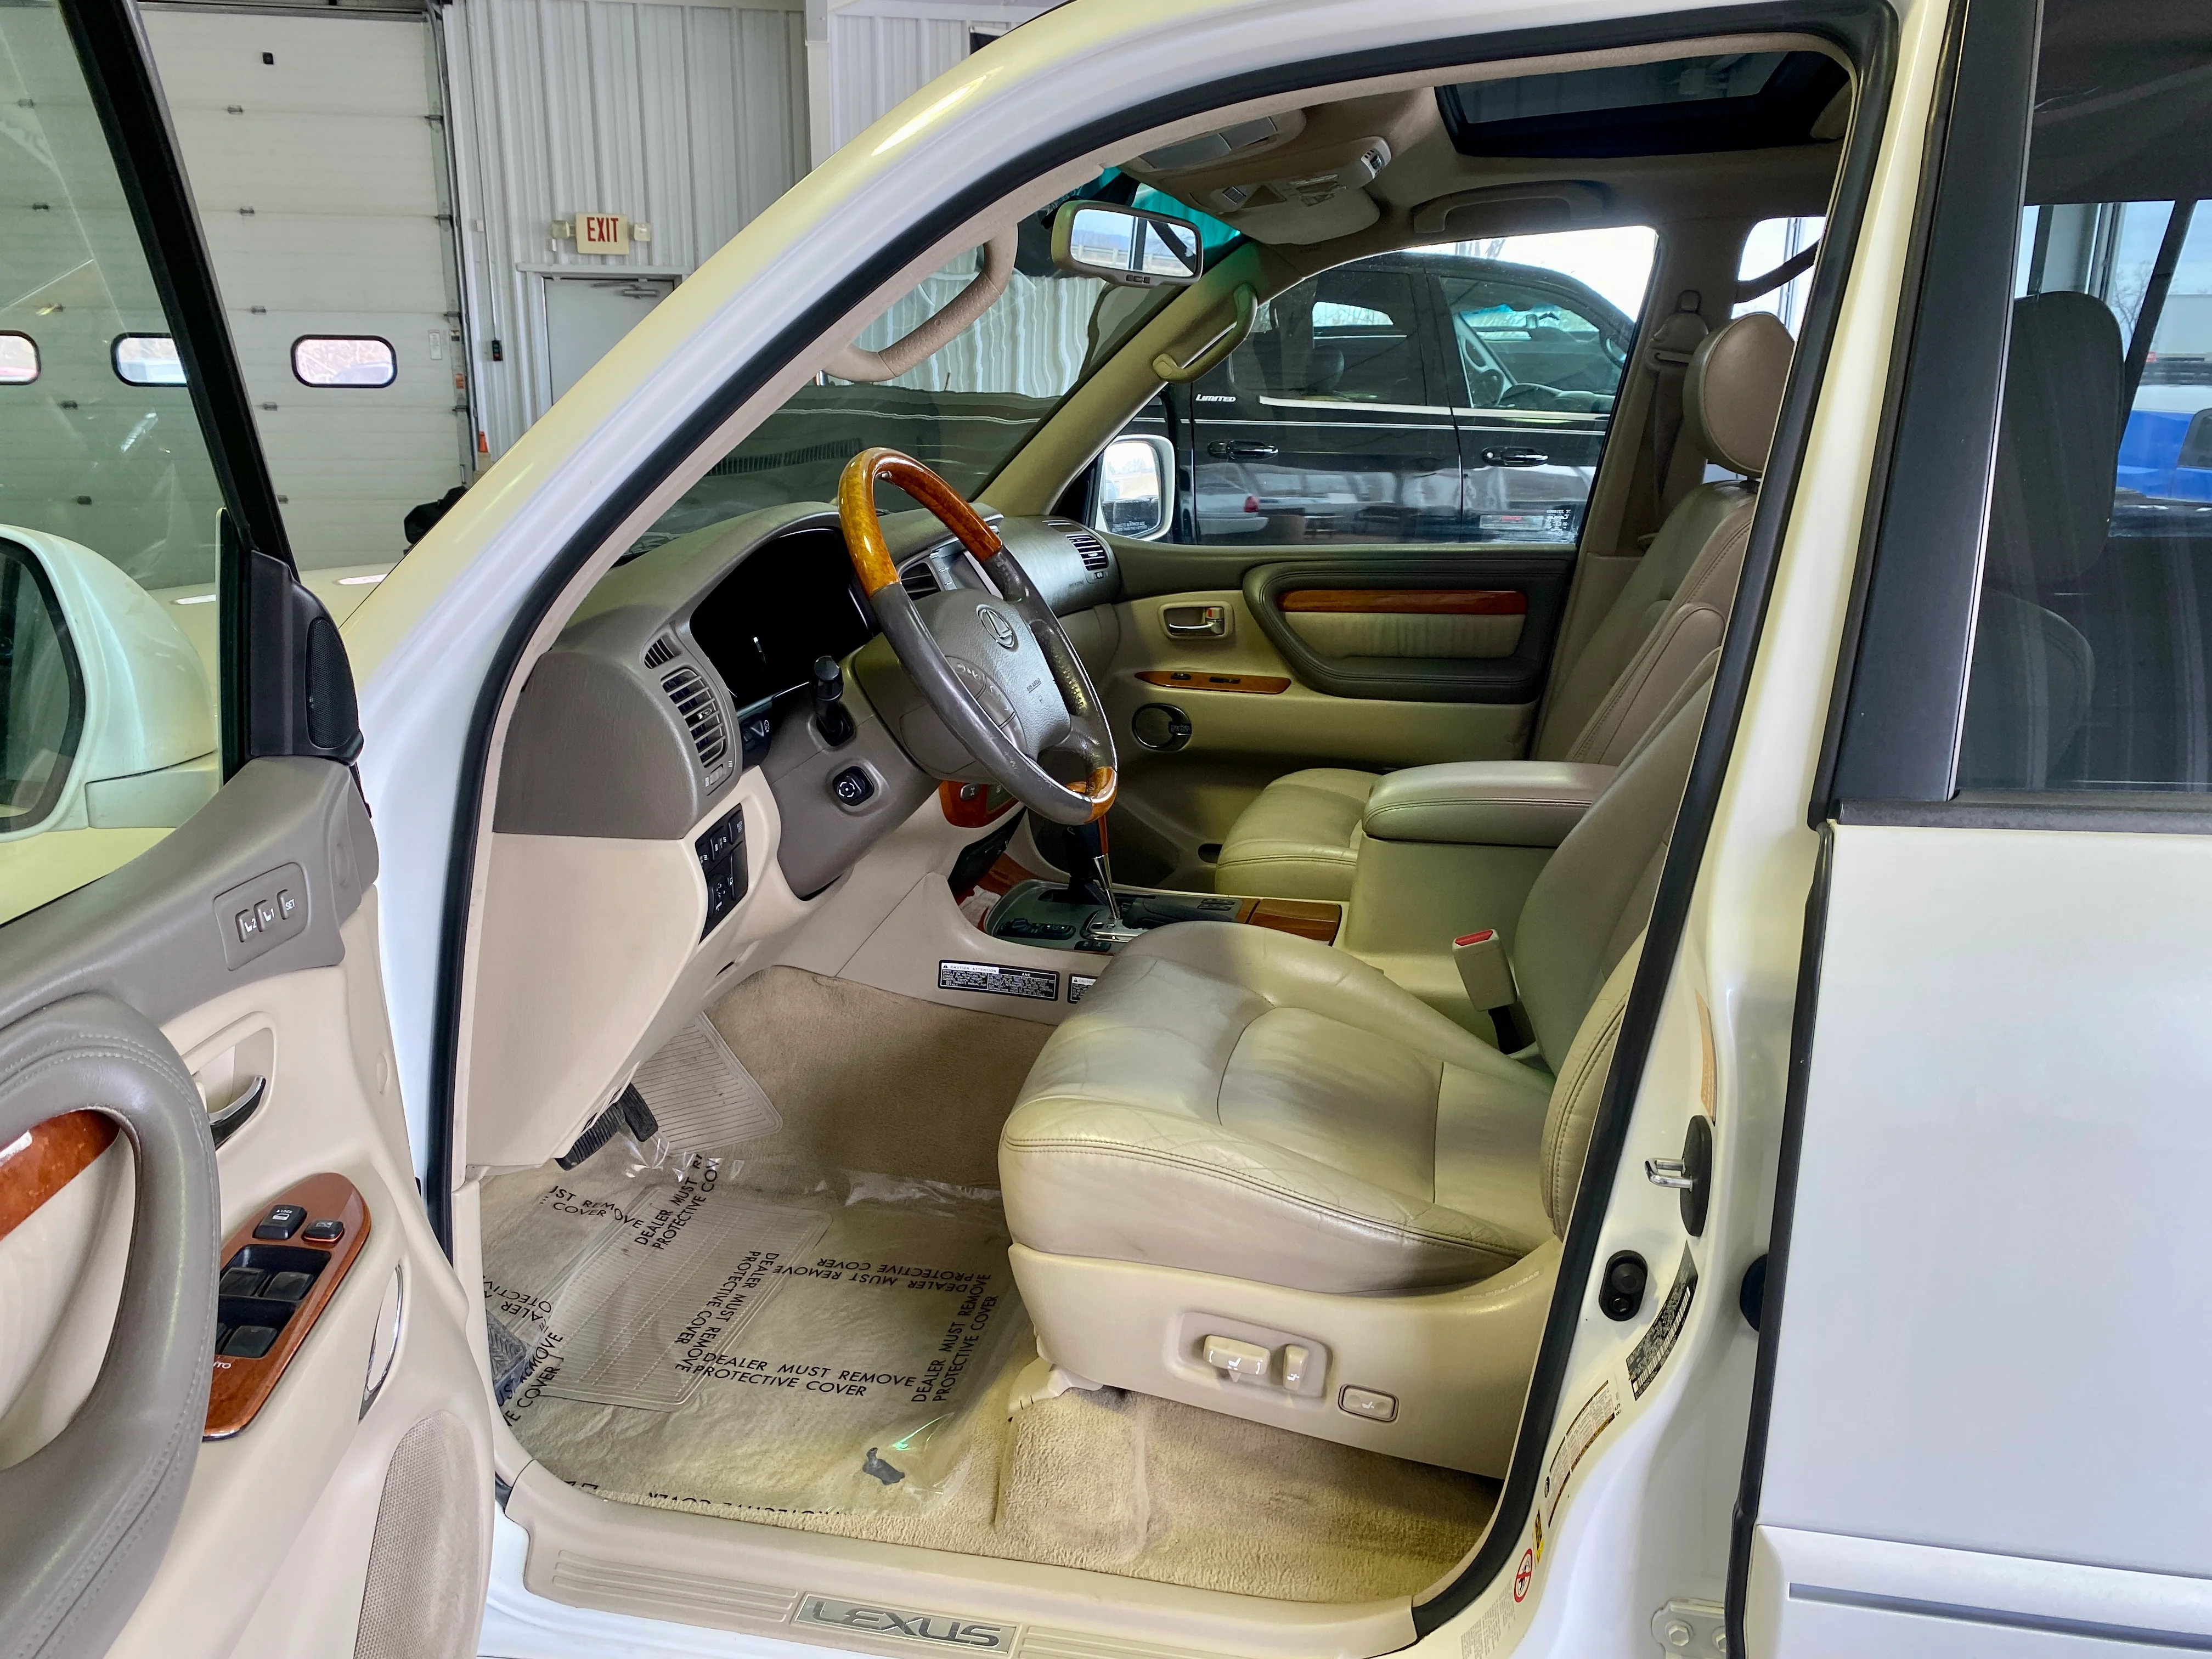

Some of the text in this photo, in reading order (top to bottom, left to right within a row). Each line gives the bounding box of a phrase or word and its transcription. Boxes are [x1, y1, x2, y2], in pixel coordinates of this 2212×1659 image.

[586, 217, 619, 242] EXIT
[285, 899, 295, 911] SET
[251, 918, 257, 929] 2
[553, 1202, 607, 1217] COVER
[582, 1200, 644, 1229] REMOVE
[634, 1177, 697, 1245] DEALER MUST
[652, 1195, 707, 1250] PROTECTIVE
[772, 1265, 968, 1293] DEALER MUST REMOVE
[817, 1257, 974, 1282] PROTECTIVE COVER
[674, 1251, 761, 1344] PROTECTIVE COVER
[675, 1252, 780, 1373] DEALER MUST REMOVE
[911, 1274, 991, 1402] DEALER MUST REMOVE
[932, 1295, 998, 1402] PROTECTIVE COVER
[517, 1366, 561, 1408] COVER
[692, 1364, 867, 1396] PROTECTIVE COVER
[703, 1352, 917, 1387] DEALER MUST REMOVE
[812, 1601, 1001, 1647] LEXUS
